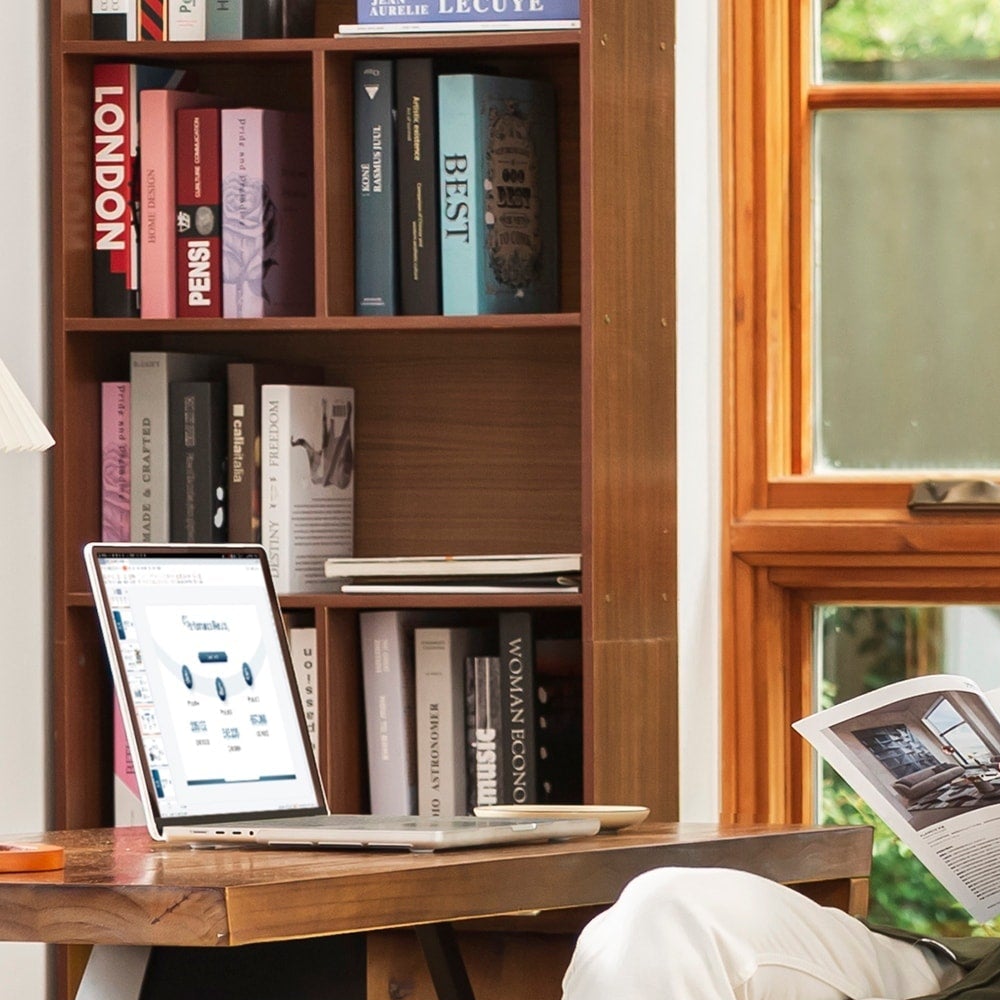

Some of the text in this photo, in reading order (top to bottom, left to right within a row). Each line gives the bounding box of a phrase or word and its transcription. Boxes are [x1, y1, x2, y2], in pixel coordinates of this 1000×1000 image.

[94, 86, 126, 251] LONDON
[239, 151, 247, 171] and
[373, 125, 382, 193] RASMUS JUUL
[413, 124, 421, 162] existence
[146, 168, 156, 244] HOME DESIGN
[442, 153, 470, 244] BEST
[188, 240, 212, 307] PENSI
[142, 417, 151, 483] CRAFTED
[268, 399, 280, 468] FREEDOM
[142, 503, 151, 543] MADE
[508, 637, 525, 724] WOMAN
[429, 703, 440, 792] ASTRONOMER
[471, 728, 497, 805] music
